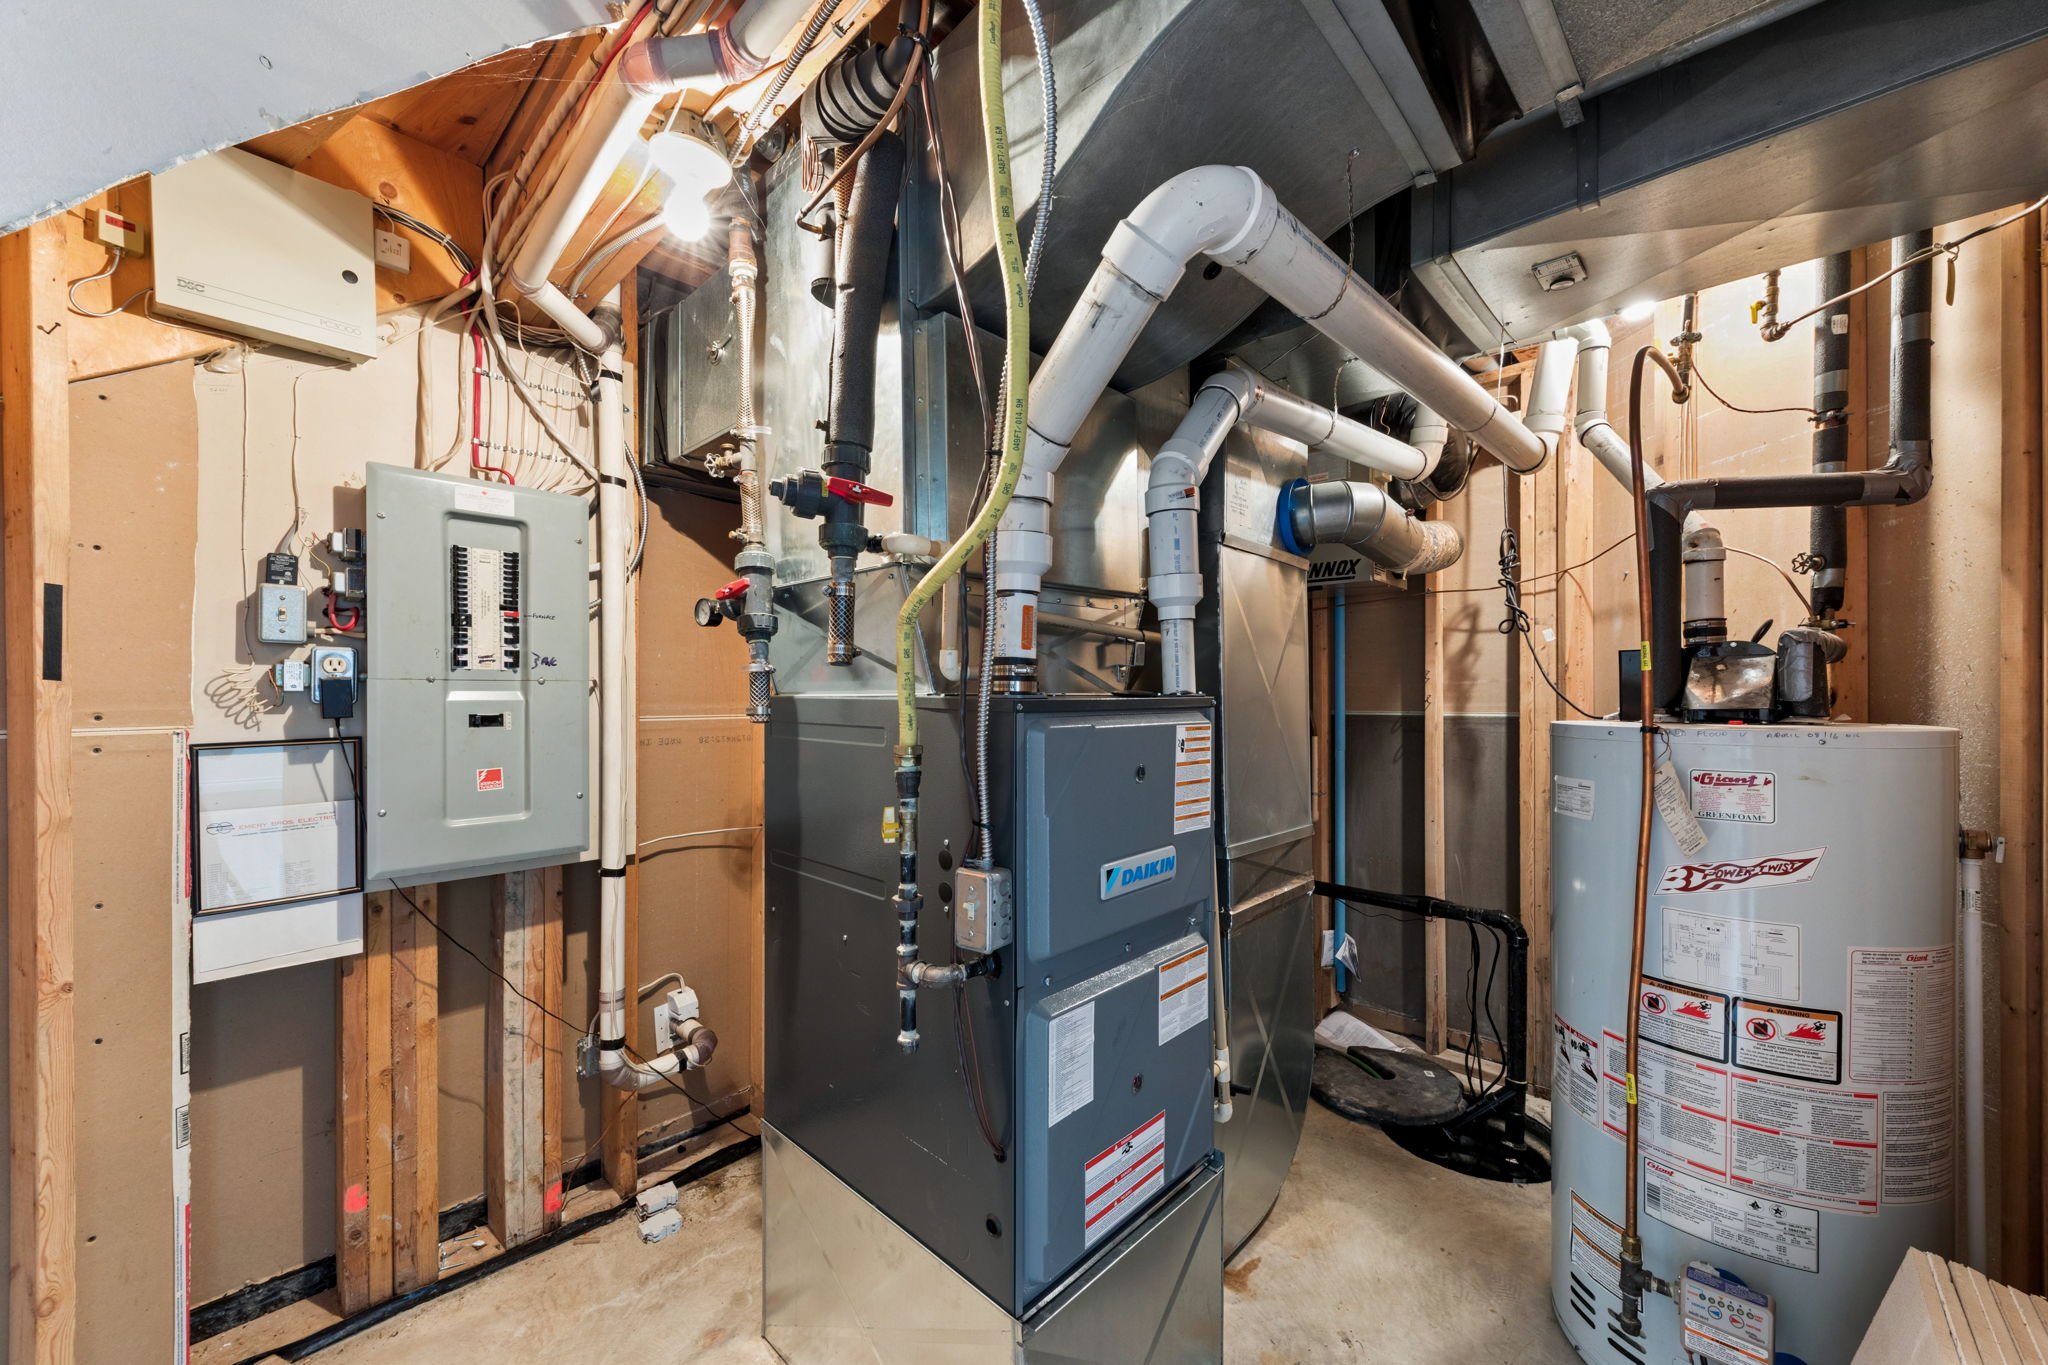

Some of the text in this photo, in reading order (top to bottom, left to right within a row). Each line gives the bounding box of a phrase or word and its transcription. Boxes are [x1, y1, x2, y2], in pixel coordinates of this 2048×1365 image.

[1002, 205, 1010, 218] GAS
[176, 278, 205, 293] DSC
[1308, 559, 1361, 578] NNOX
[1700, 773, 1758, 787] Giant
[239, 822, 267, 830] EMERY
[1121, 855, 1175, 887] DAIKIN
[1702, 862, 1798, 881] POWER TWIST
[1656, 983, 1710, 1000] AVERTISSEMENT
[1776, 1007, 1811, 1018] WARNING
[1646, 1161, 1675, 1177] Giant
